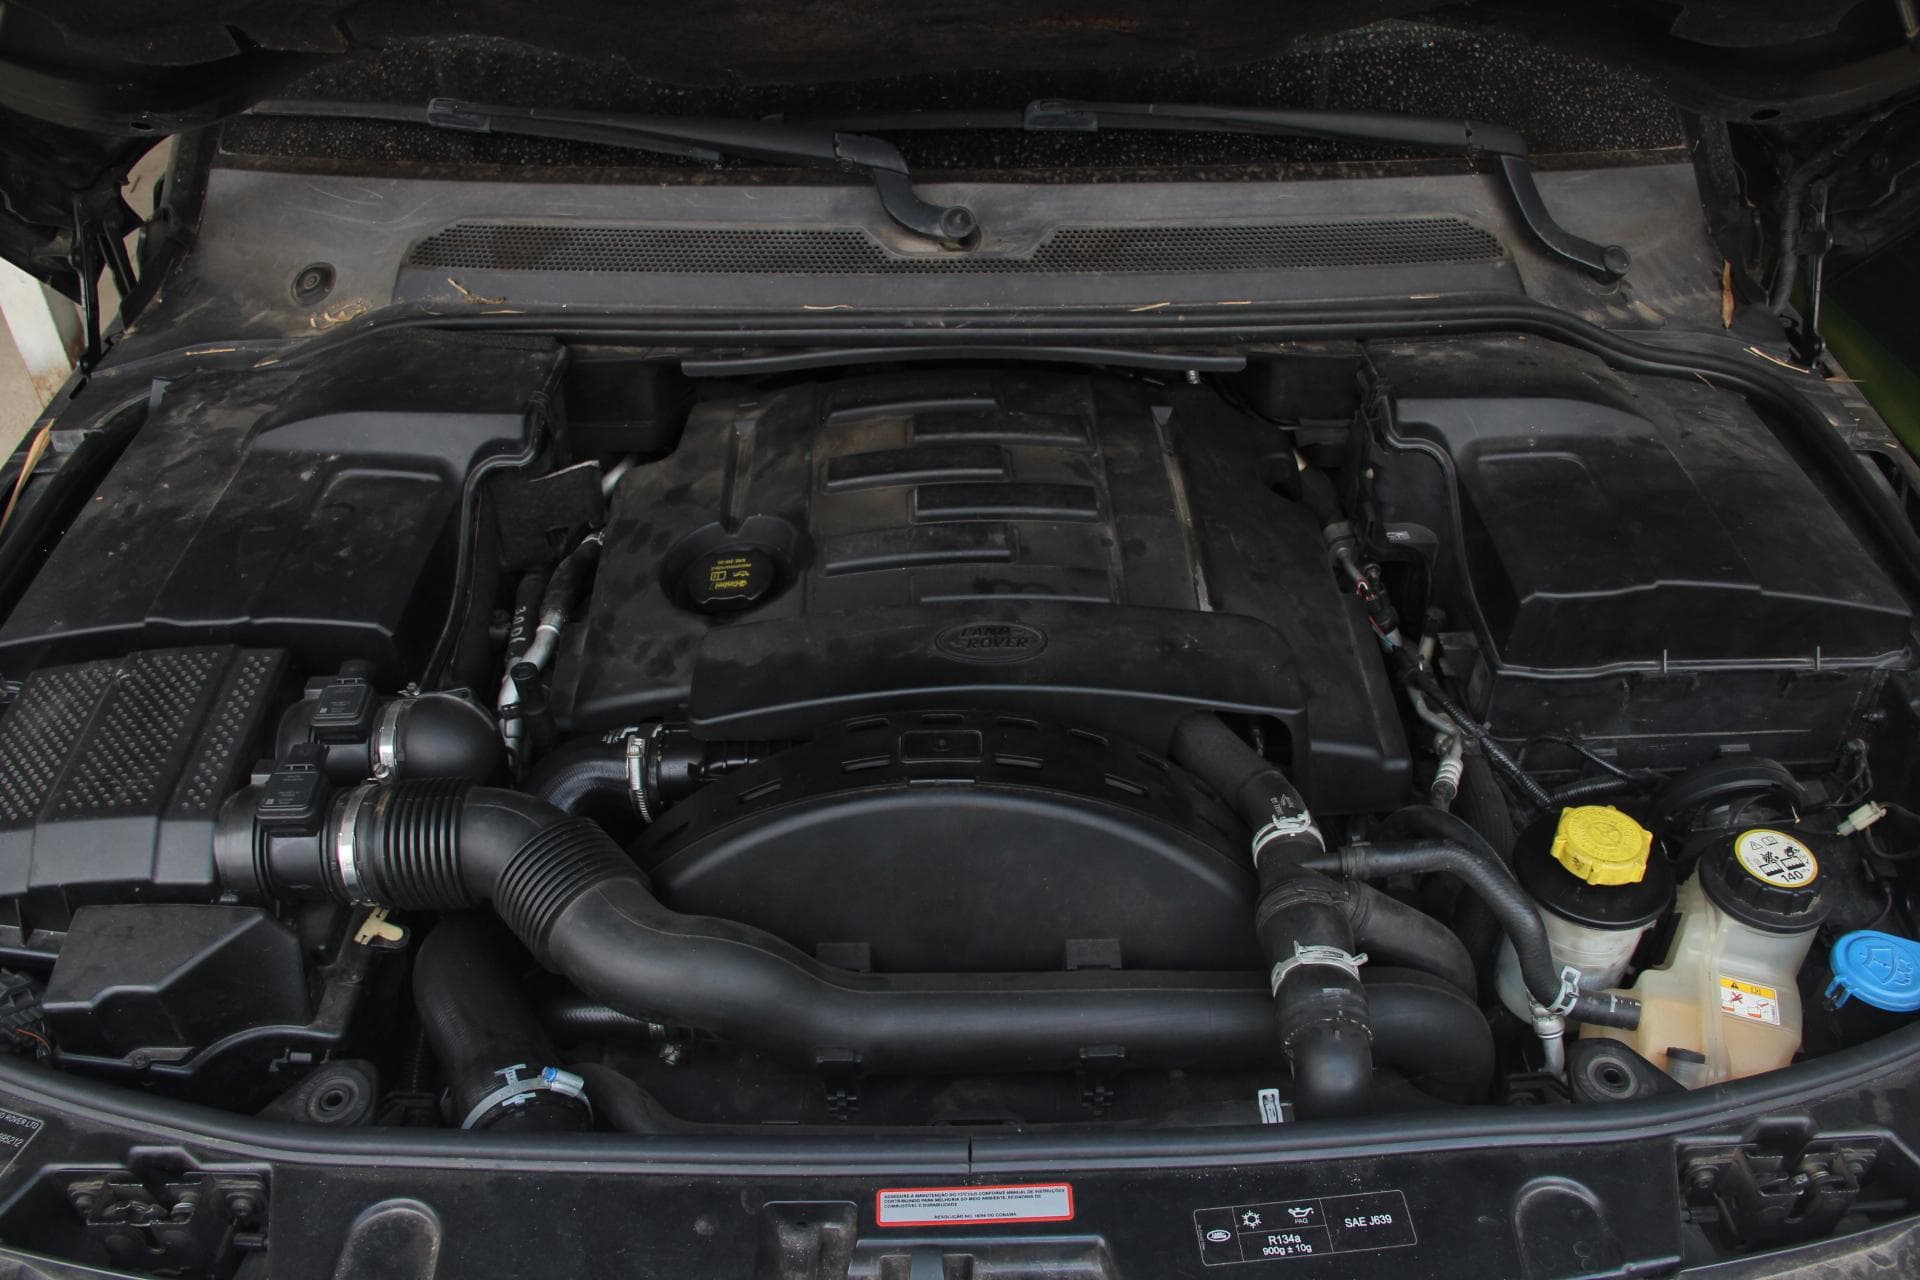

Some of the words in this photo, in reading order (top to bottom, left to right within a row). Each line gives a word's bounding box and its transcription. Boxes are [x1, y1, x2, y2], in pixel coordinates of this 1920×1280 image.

[967, 637, 1029, 649] ROVER
[1781, 870, 1803, 883] 140
[1344, 1217, 1367, 1228] SAE
[1369, 1214, 1393, 1226] J639
[1267, 1233, 1302, 1246] R134a
[1262, 1246, 1286, 1256] 900g
[1295, 1243, 1313, 1253] 10g
